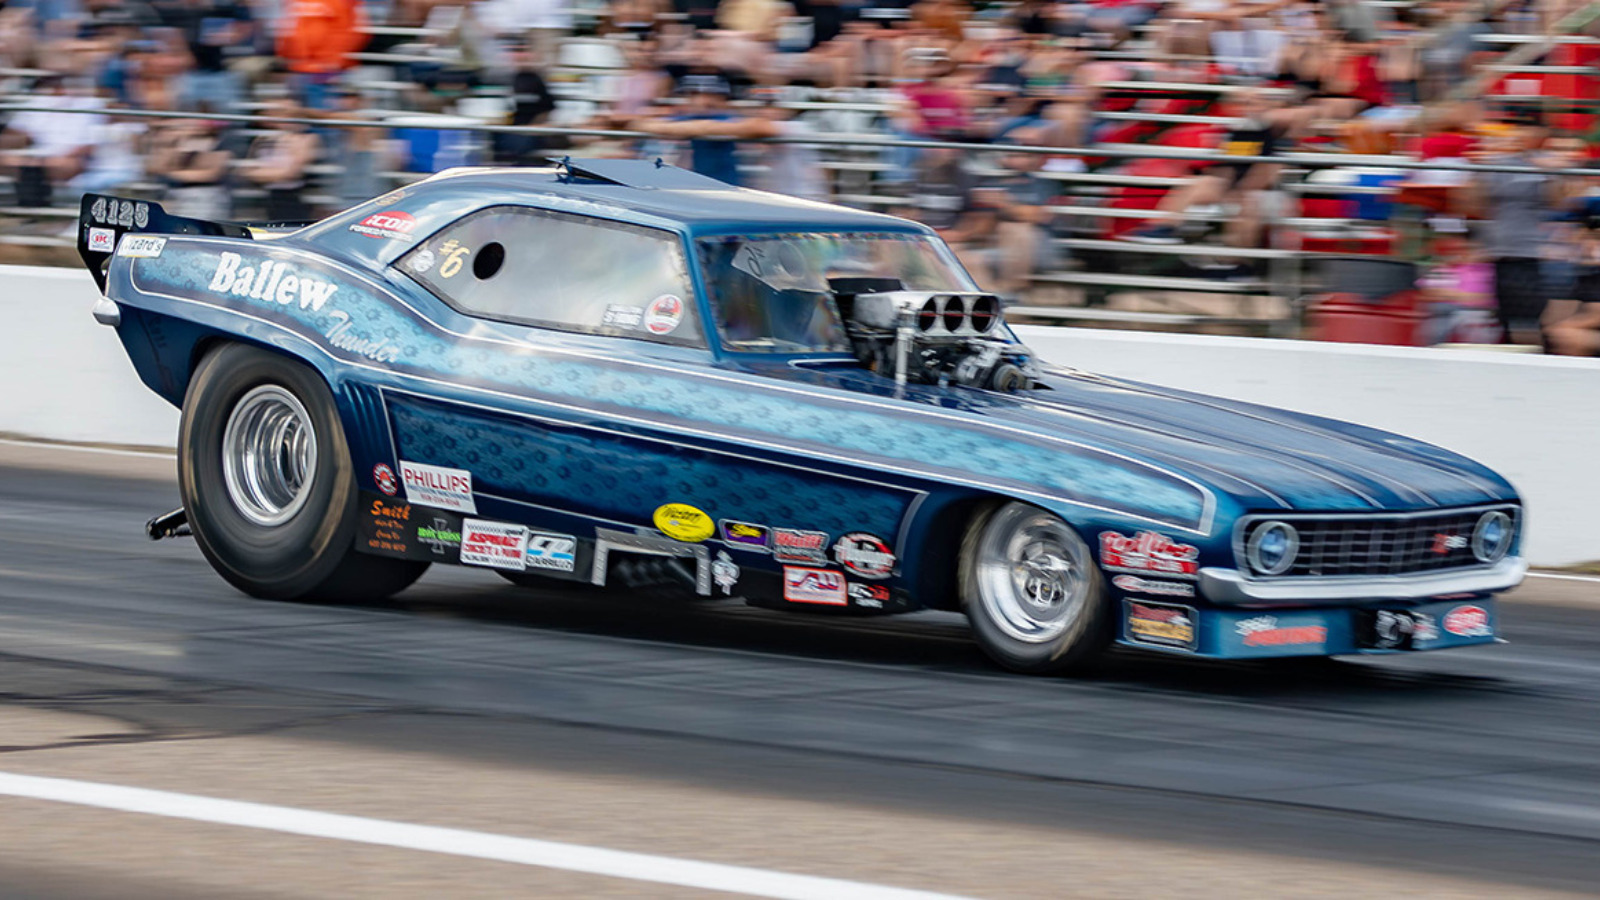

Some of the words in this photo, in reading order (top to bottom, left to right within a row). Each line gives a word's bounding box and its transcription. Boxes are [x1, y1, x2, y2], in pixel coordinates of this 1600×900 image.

[91, 198, 149, 229] 4125
[208, 251, 338, 312] Ballew
[325, 310, 400, 363] Thunder
[403, 467, 470, 494] PHILLIPS
[370, 500, 411, 521] Smith
[469, 531, 522, 548] ASPHALT
